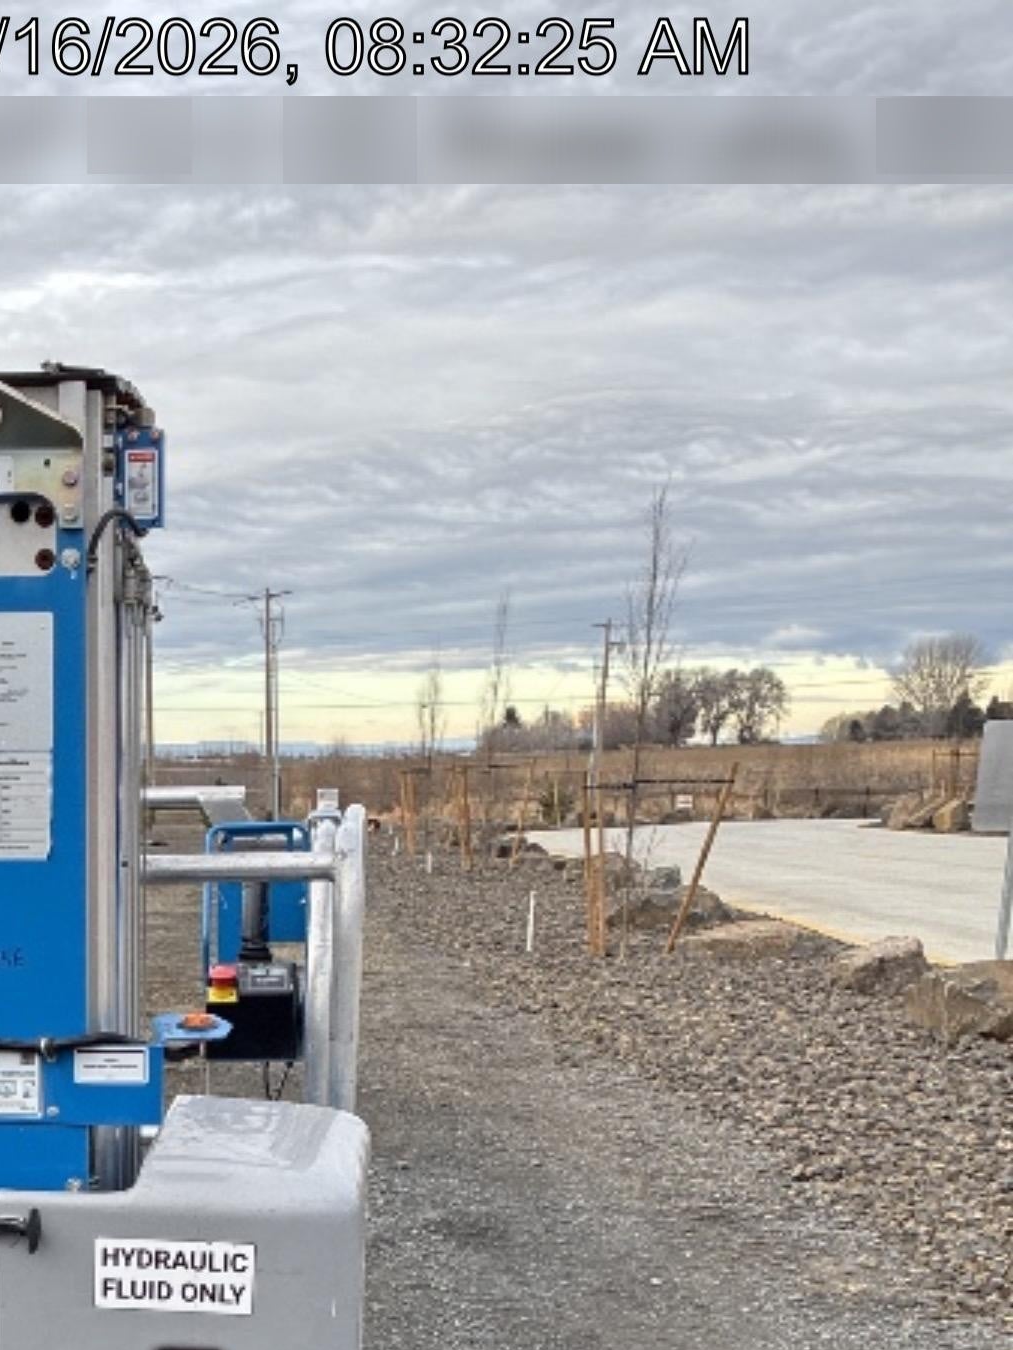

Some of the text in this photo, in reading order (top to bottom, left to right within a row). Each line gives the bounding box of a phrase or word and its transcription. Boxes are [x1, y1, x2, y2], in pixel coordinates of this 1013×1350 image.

[101, 1247, 249, 1273] HYDRAULIC
[102, 1278, 246, 1305] FLUID ONLY
